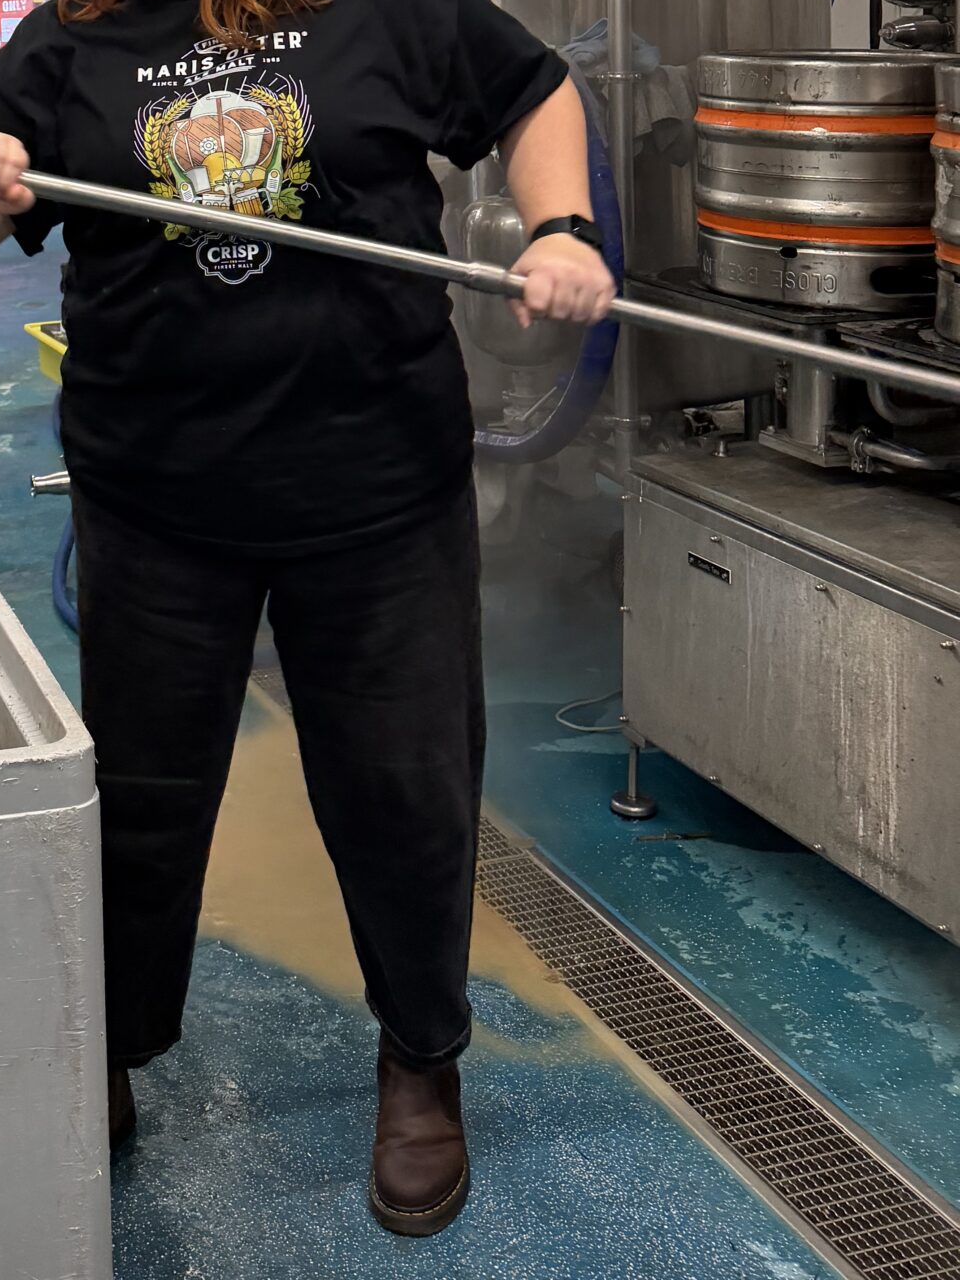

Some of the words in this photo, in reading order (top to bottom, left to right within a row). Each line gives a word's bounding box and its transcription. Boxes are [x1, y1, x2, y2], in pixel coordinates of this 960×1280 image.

[2, 0, 28, 11] ONLY
[137, 56, 214, 83] MARIS
[215, 56, 255, 72] MALT
[207, 244, 260, 263] CRISP
